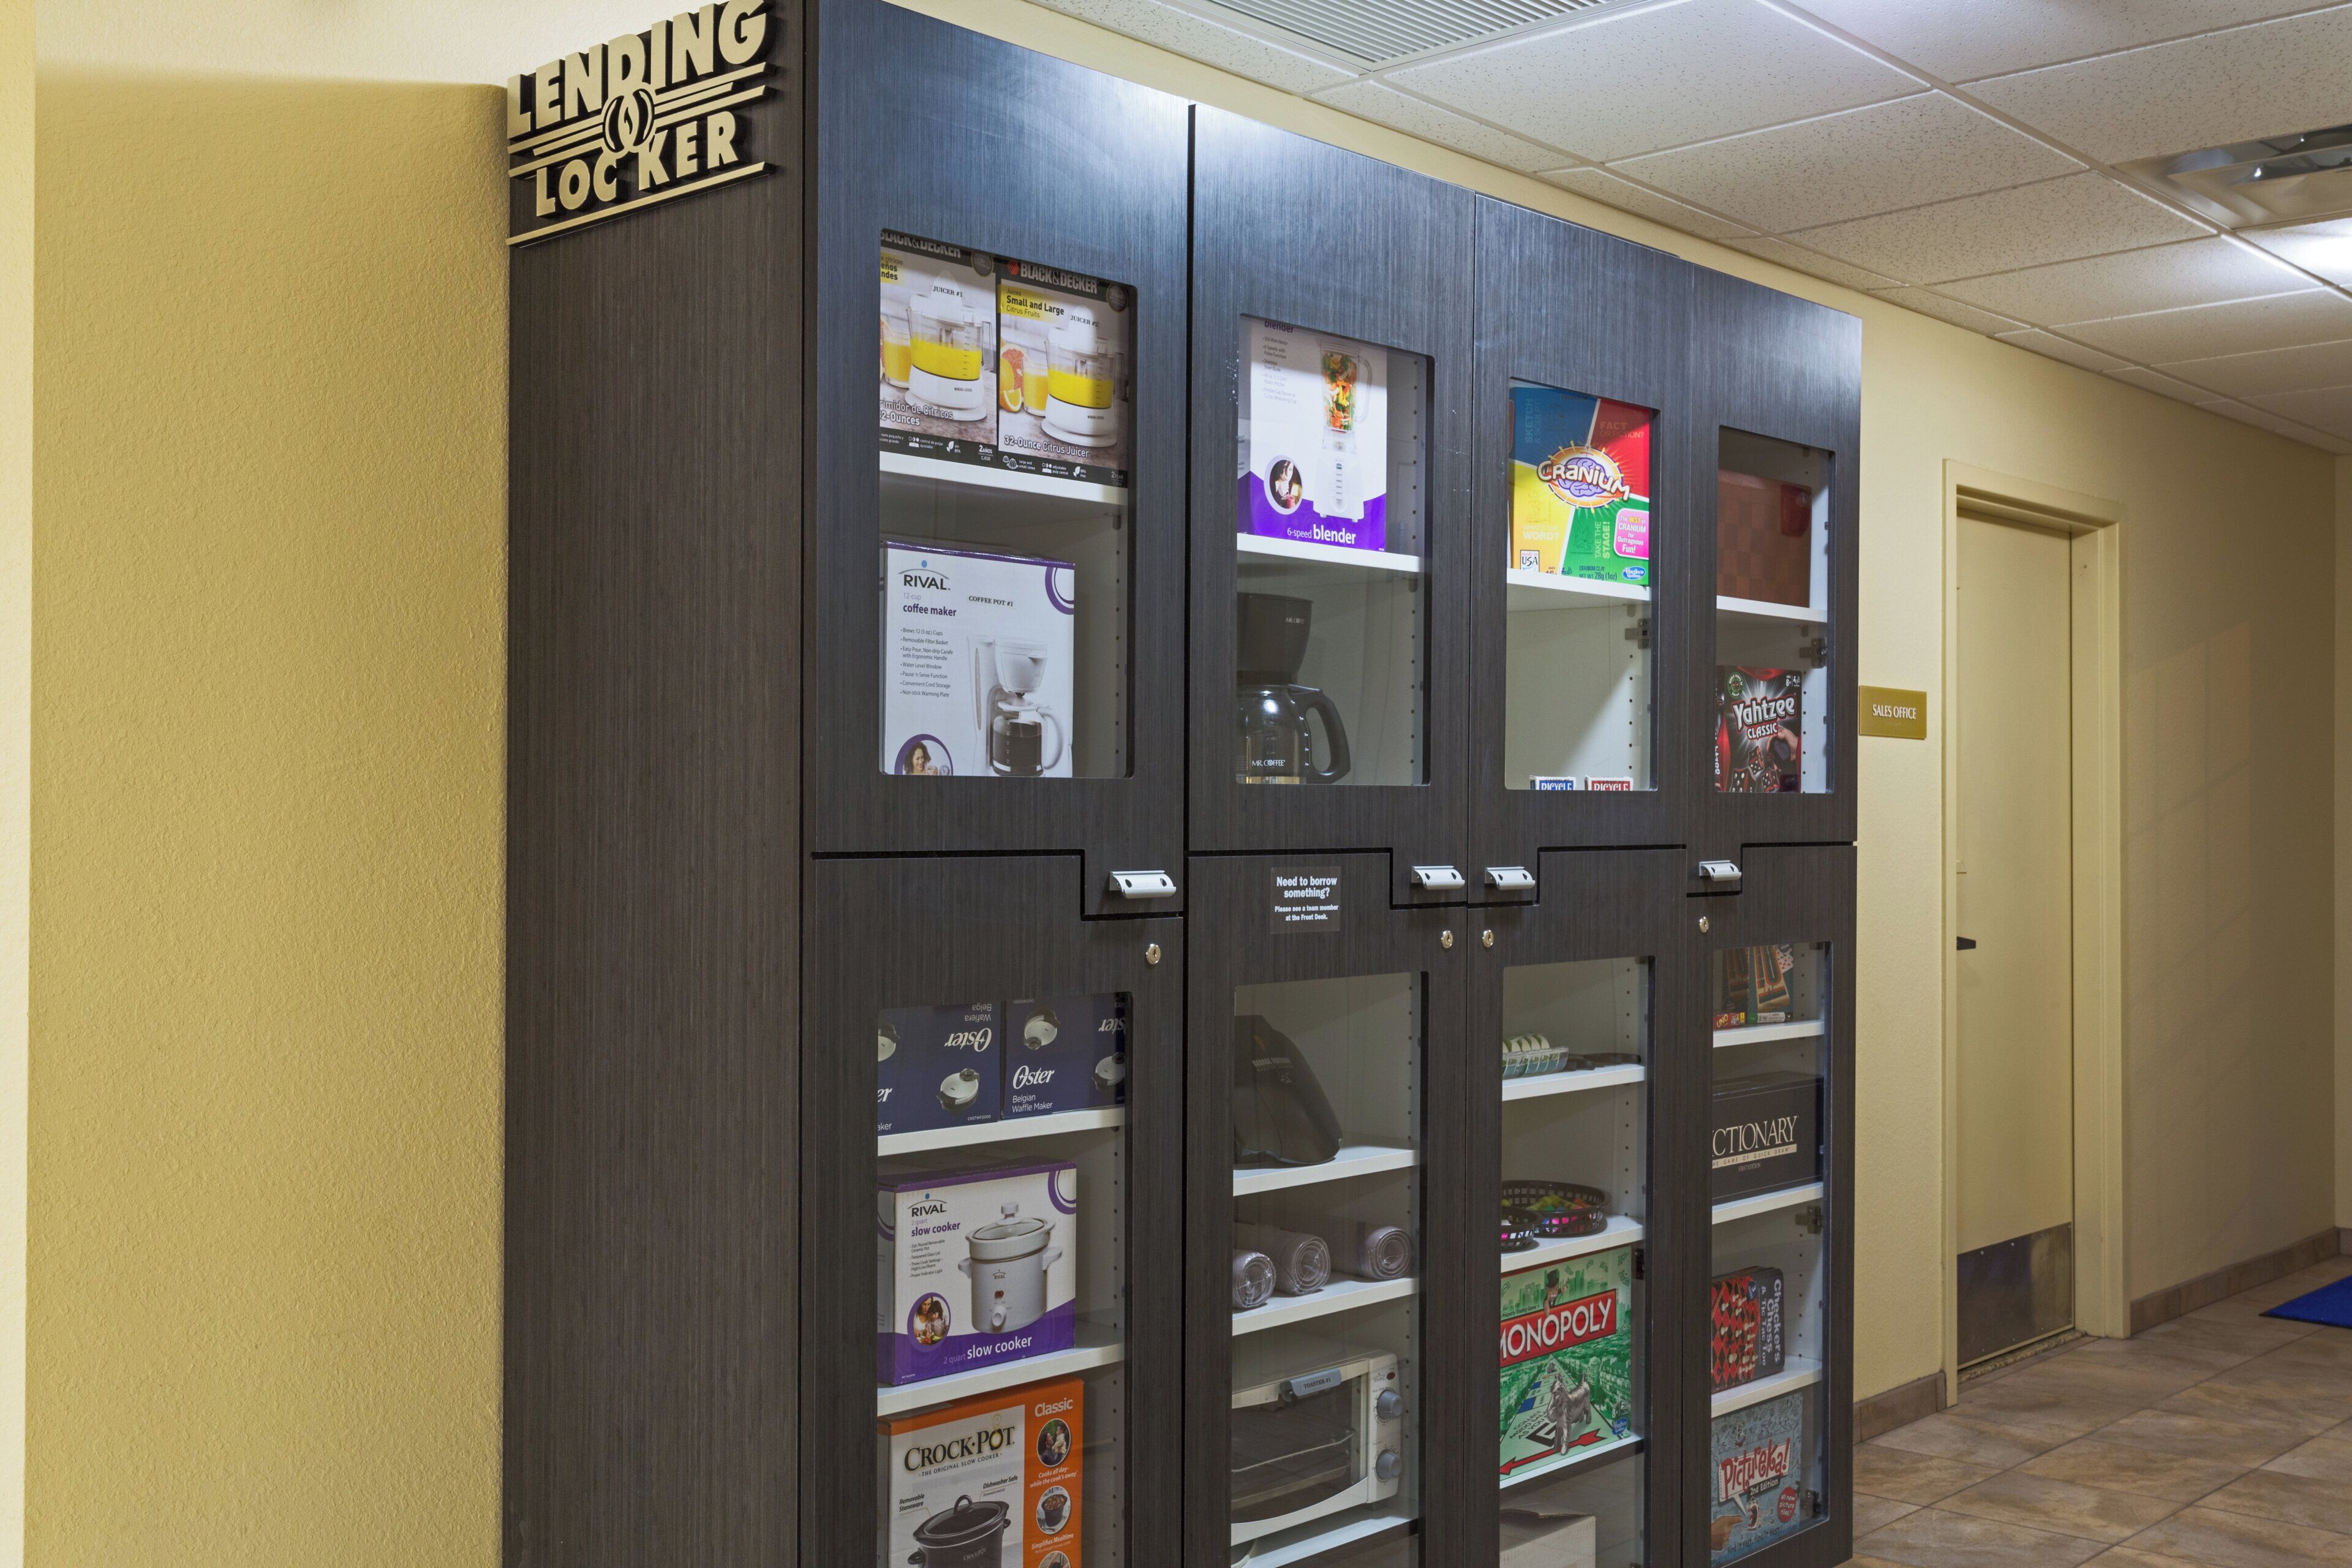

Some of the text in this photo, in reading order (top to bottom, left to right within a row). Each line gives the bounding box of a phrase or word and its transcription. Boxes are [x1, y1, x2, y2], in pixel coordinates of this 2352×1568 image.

[507, 0, 766, 139] LENDING
[537, 111, 738, 216] LOCKER
[881, 271, 898, 280] ndes
[1020, 263, 1097, 294] BLACK&DECKER
[933, 286, 955, 295] JUICER
[1006, 288, 1022, 296] Juices
[1006, 295, 1064, 316] Small and Large
[1006, 305, 1040, 318] Citrus Fruits
[1070, 315, 1090, 325] JUICER
[911, 404, 921, 414] de
[924, 405, 953, 420] Cítricos
[1600, 421, 1627, 430] FACT
[1004, 435, 1089, 458] 32-Ounce Citrus Juicer
[1287, 524, 1356, 545] 6-speed blender
[1618, 523, 1646, 533] CRANIUM
[1523, 531, 1559, 540] WORD?
[1618, 537, 1644, 545] Outrageous
[1622, 544, 1635, 554] Fun!
[1522, 556, 1537, 567] USA
[903, 575, 947, 590] RIVAL
[969, 595, 992, 604] COFFEE
[903, 603, 957, 616] coffee maker
[1732, 697, 1795, 731] Yahtzee
[1873, 704, 1916, 719] SALES OFFICE
[1747, 723, 1777, 739] CLASSIC
[1276, 876, 1338, 887] Need to borrow
[1284, 887, 1330, 899] something?
[1098, 1017, 1126, 1035] ster
[1716, 1014, 1728, 1028] UNO
[944, 1028, 992, 1052] Oster
[1013, 1066, 1055, 1089] Oster
[1013, 1094, 1035, 1103] Belgian
[1012, 1104, 1031, 1112] Waffle
[1713, 1116, 1797, 1156] CTIONARY
[911, 1204, 946, 1218] RIVAL
[911, 1221, 960, 1237] slow cooker
[949, 1354, 966, 1365] quart
[967, 1345, 992, 1359] slow
[995, 1336, 1032, 1353] cooker
[1303, 1379, 1325, 1389] TOASTER
[1034, 1397, 1073, 1417] Classic
[933, 1463, 959, 1474] ORIGINAL
[978, 1453, 999, 1463] COOKER
[1721, 1437, 1791, 1500] Pictureka!
[1030, 1480, 1041, 1488] while
[1050, 1474, 1065, 1482] cook's
[1039, 1470, 1052, 1479] Cooks
[982, 1479, 1008, 1489] Dishwasher
[1750, 1479, 1779, 1496] 2nd Edition
[899, 1493, 925, 1504] Removable
[899, 1501, 924, 1512] Stoneware
[1031, 1540, 1054, 1550] Simplifies
[1054, 1533, 1074, 1542] Mealtime
